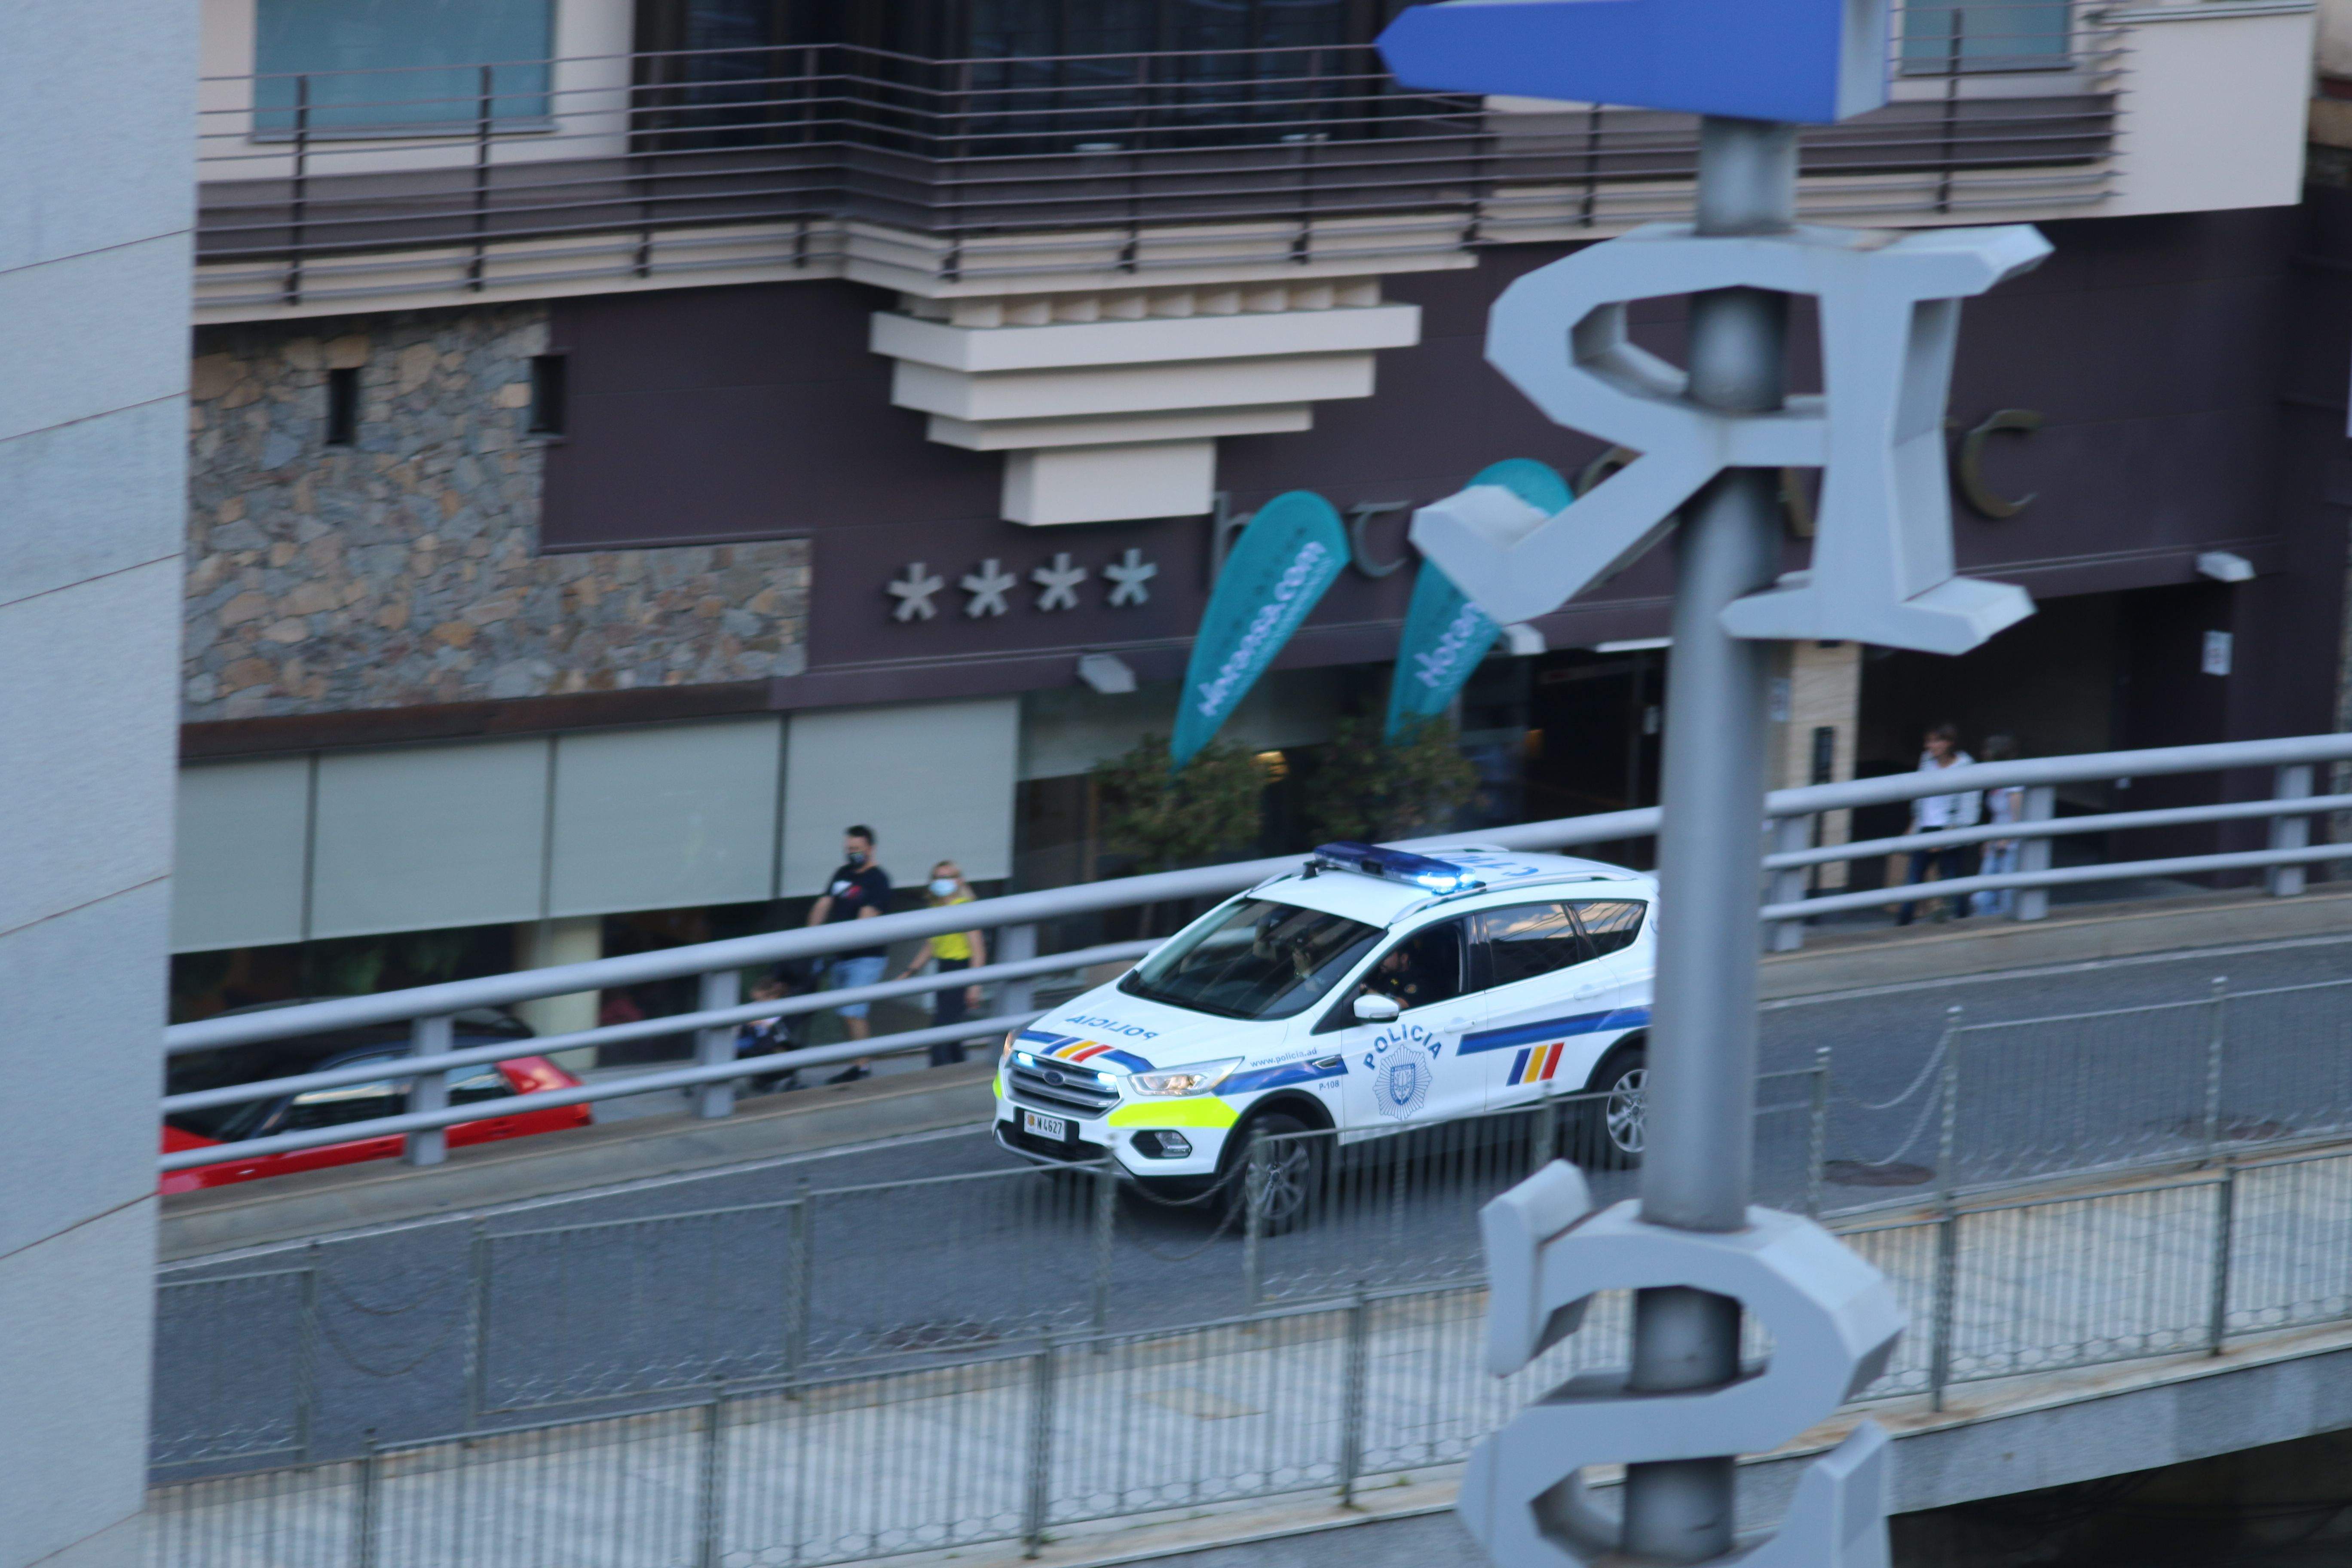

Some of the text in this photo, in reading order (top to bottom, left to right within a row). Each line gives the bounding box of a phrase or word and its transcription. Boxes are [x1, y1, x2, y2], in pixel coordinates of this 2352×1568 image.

[1363, 1024, 1442, 1070] POLICIA
[1250, 1047, 1317, 1067] www.policia.ad
[1319, 1080, 1339, 1091] P-108
[1044, 1119, 1062, 1135] 4627
